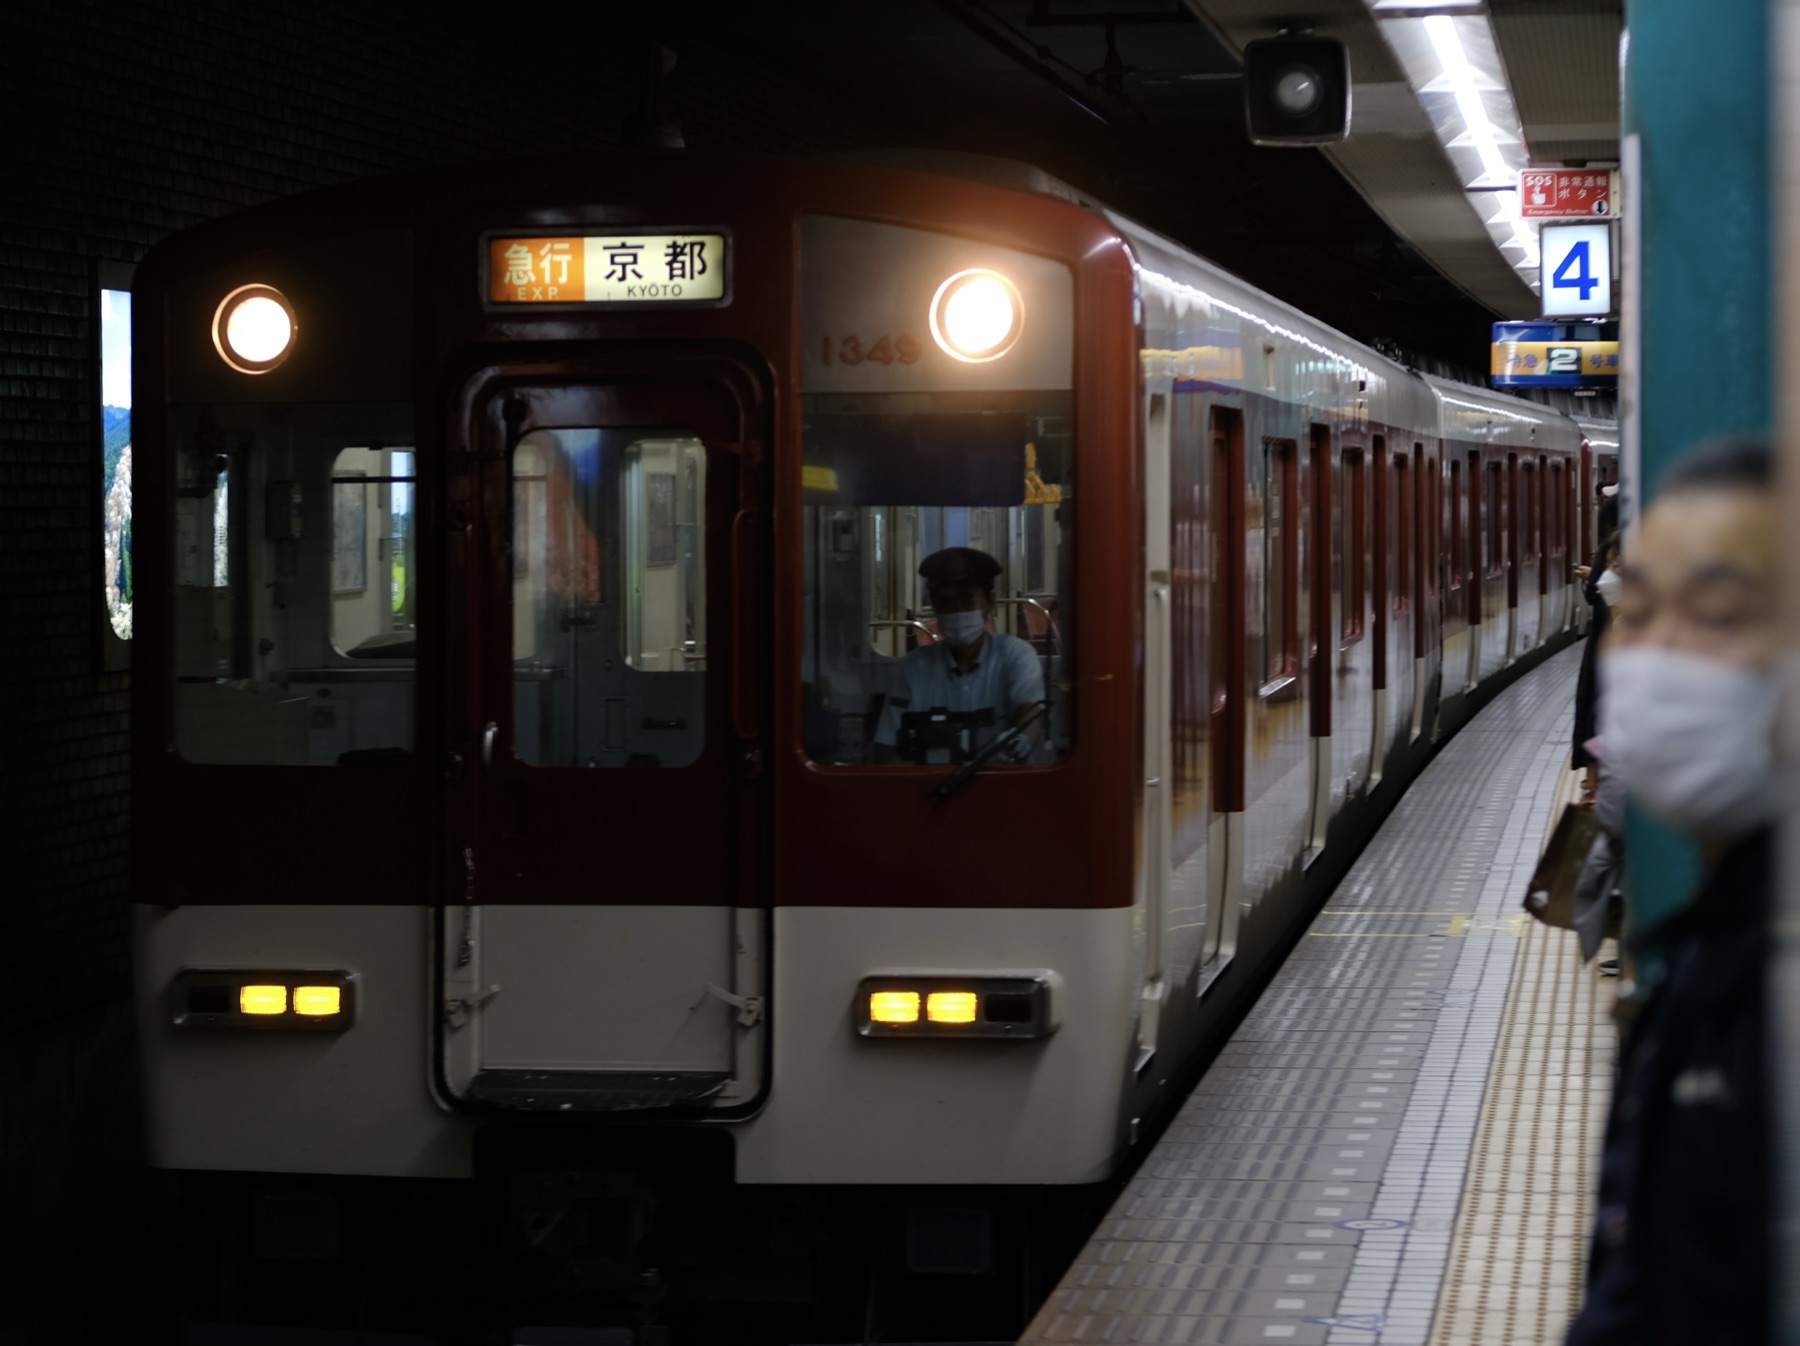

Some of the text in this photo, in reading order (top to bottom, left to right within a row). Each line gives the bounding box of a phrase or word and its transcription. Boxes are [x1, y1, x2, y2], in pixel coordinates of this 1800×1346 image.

[1525, 175, 1553, 186] SOS
[1558, 175, 1608, 187] 非常通報
[1558, 188, 1608, 199] ボタン
[503, 242, 573, 285] 急行
[601, 240, 707, 283] 京都
[1553, 241, 1599, 300] 4
[822, 334, 922, 367] 1349
[1550, 348, 1578, 371] 2
